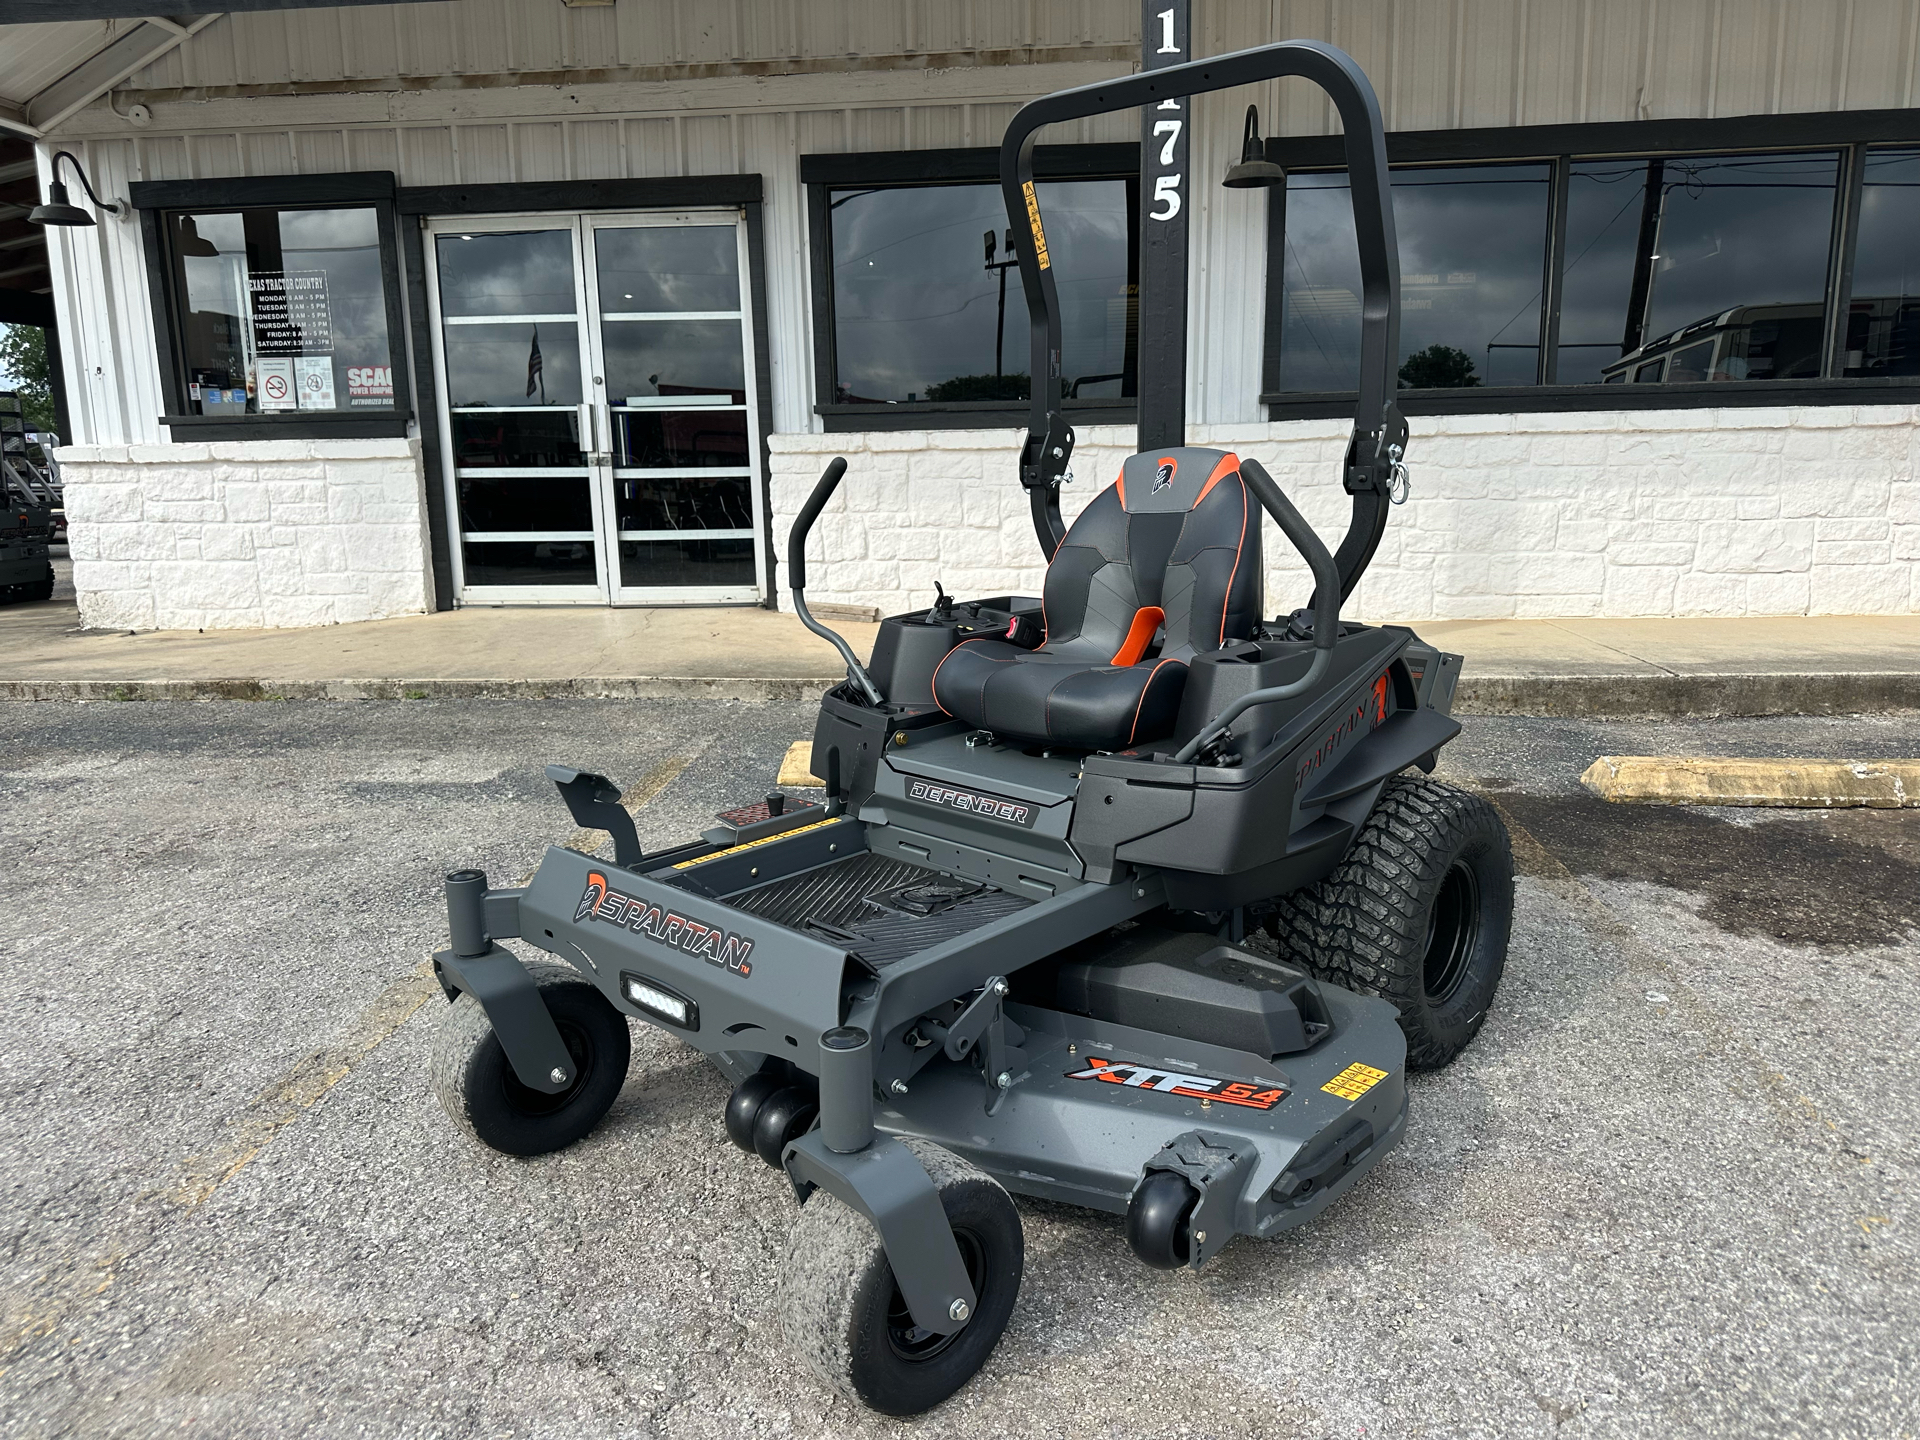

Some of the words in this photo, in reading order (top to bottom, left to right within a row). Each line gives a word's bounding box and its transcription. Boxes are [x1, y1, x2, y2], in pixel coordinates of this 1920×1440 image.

[1150, 8, 1182, 221] 175
[266, 278, 294, 291] TRACTOR
[295, 277, 322, 290] COUNTRY
[350, 387, 368, 395] POWER
[351, 398, 382, 406] AUTHORIZED
[910, 782, 1028, 824] DEFENDER
[597, 891, 752, 970] SPARTAN
[1065, 1057, 1222, 1093] XTF
[1220, 1082, 1285, 1104] 54
